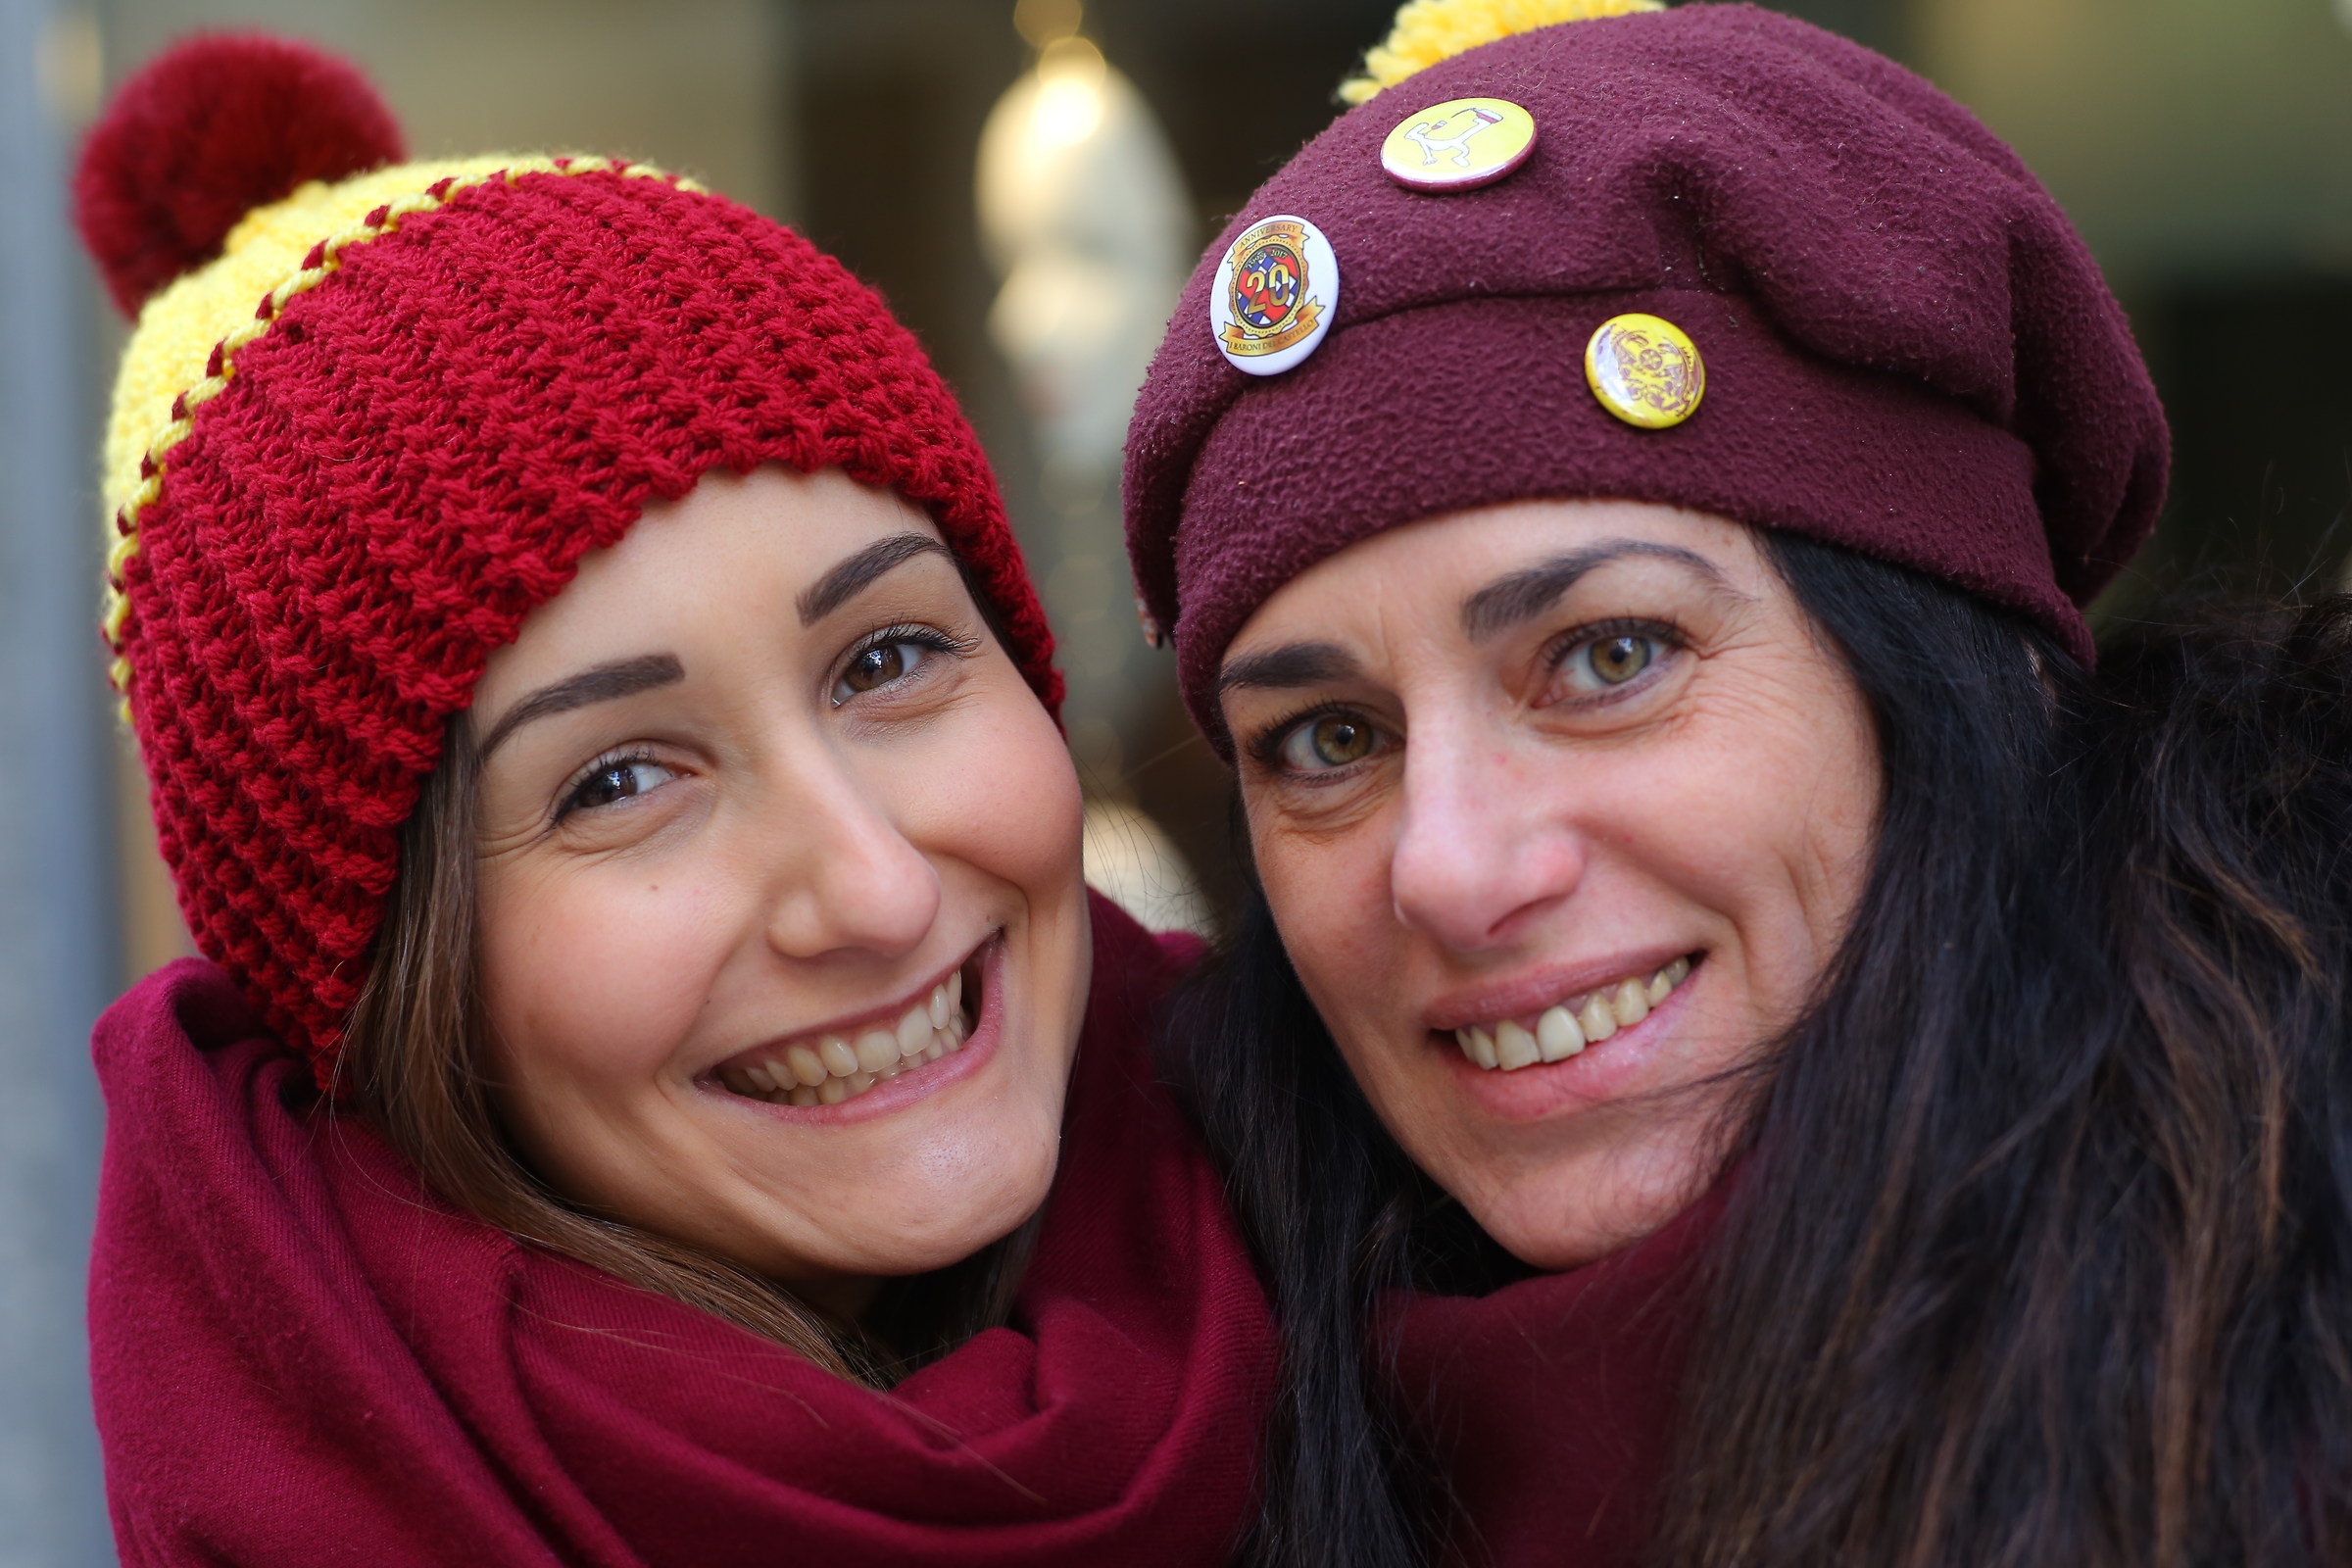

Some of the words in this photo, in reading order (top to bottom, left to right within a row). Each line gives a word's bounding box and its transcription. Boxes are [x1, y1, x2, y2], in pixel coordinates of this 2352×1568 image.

[1240, 224, 1298, 248] ANNIVERSARY
[1270, 249, 1289, 259] 2017
[1247, 264, 1290, 315] 20
[1277, 319, 1314, 343] CASTELLO
